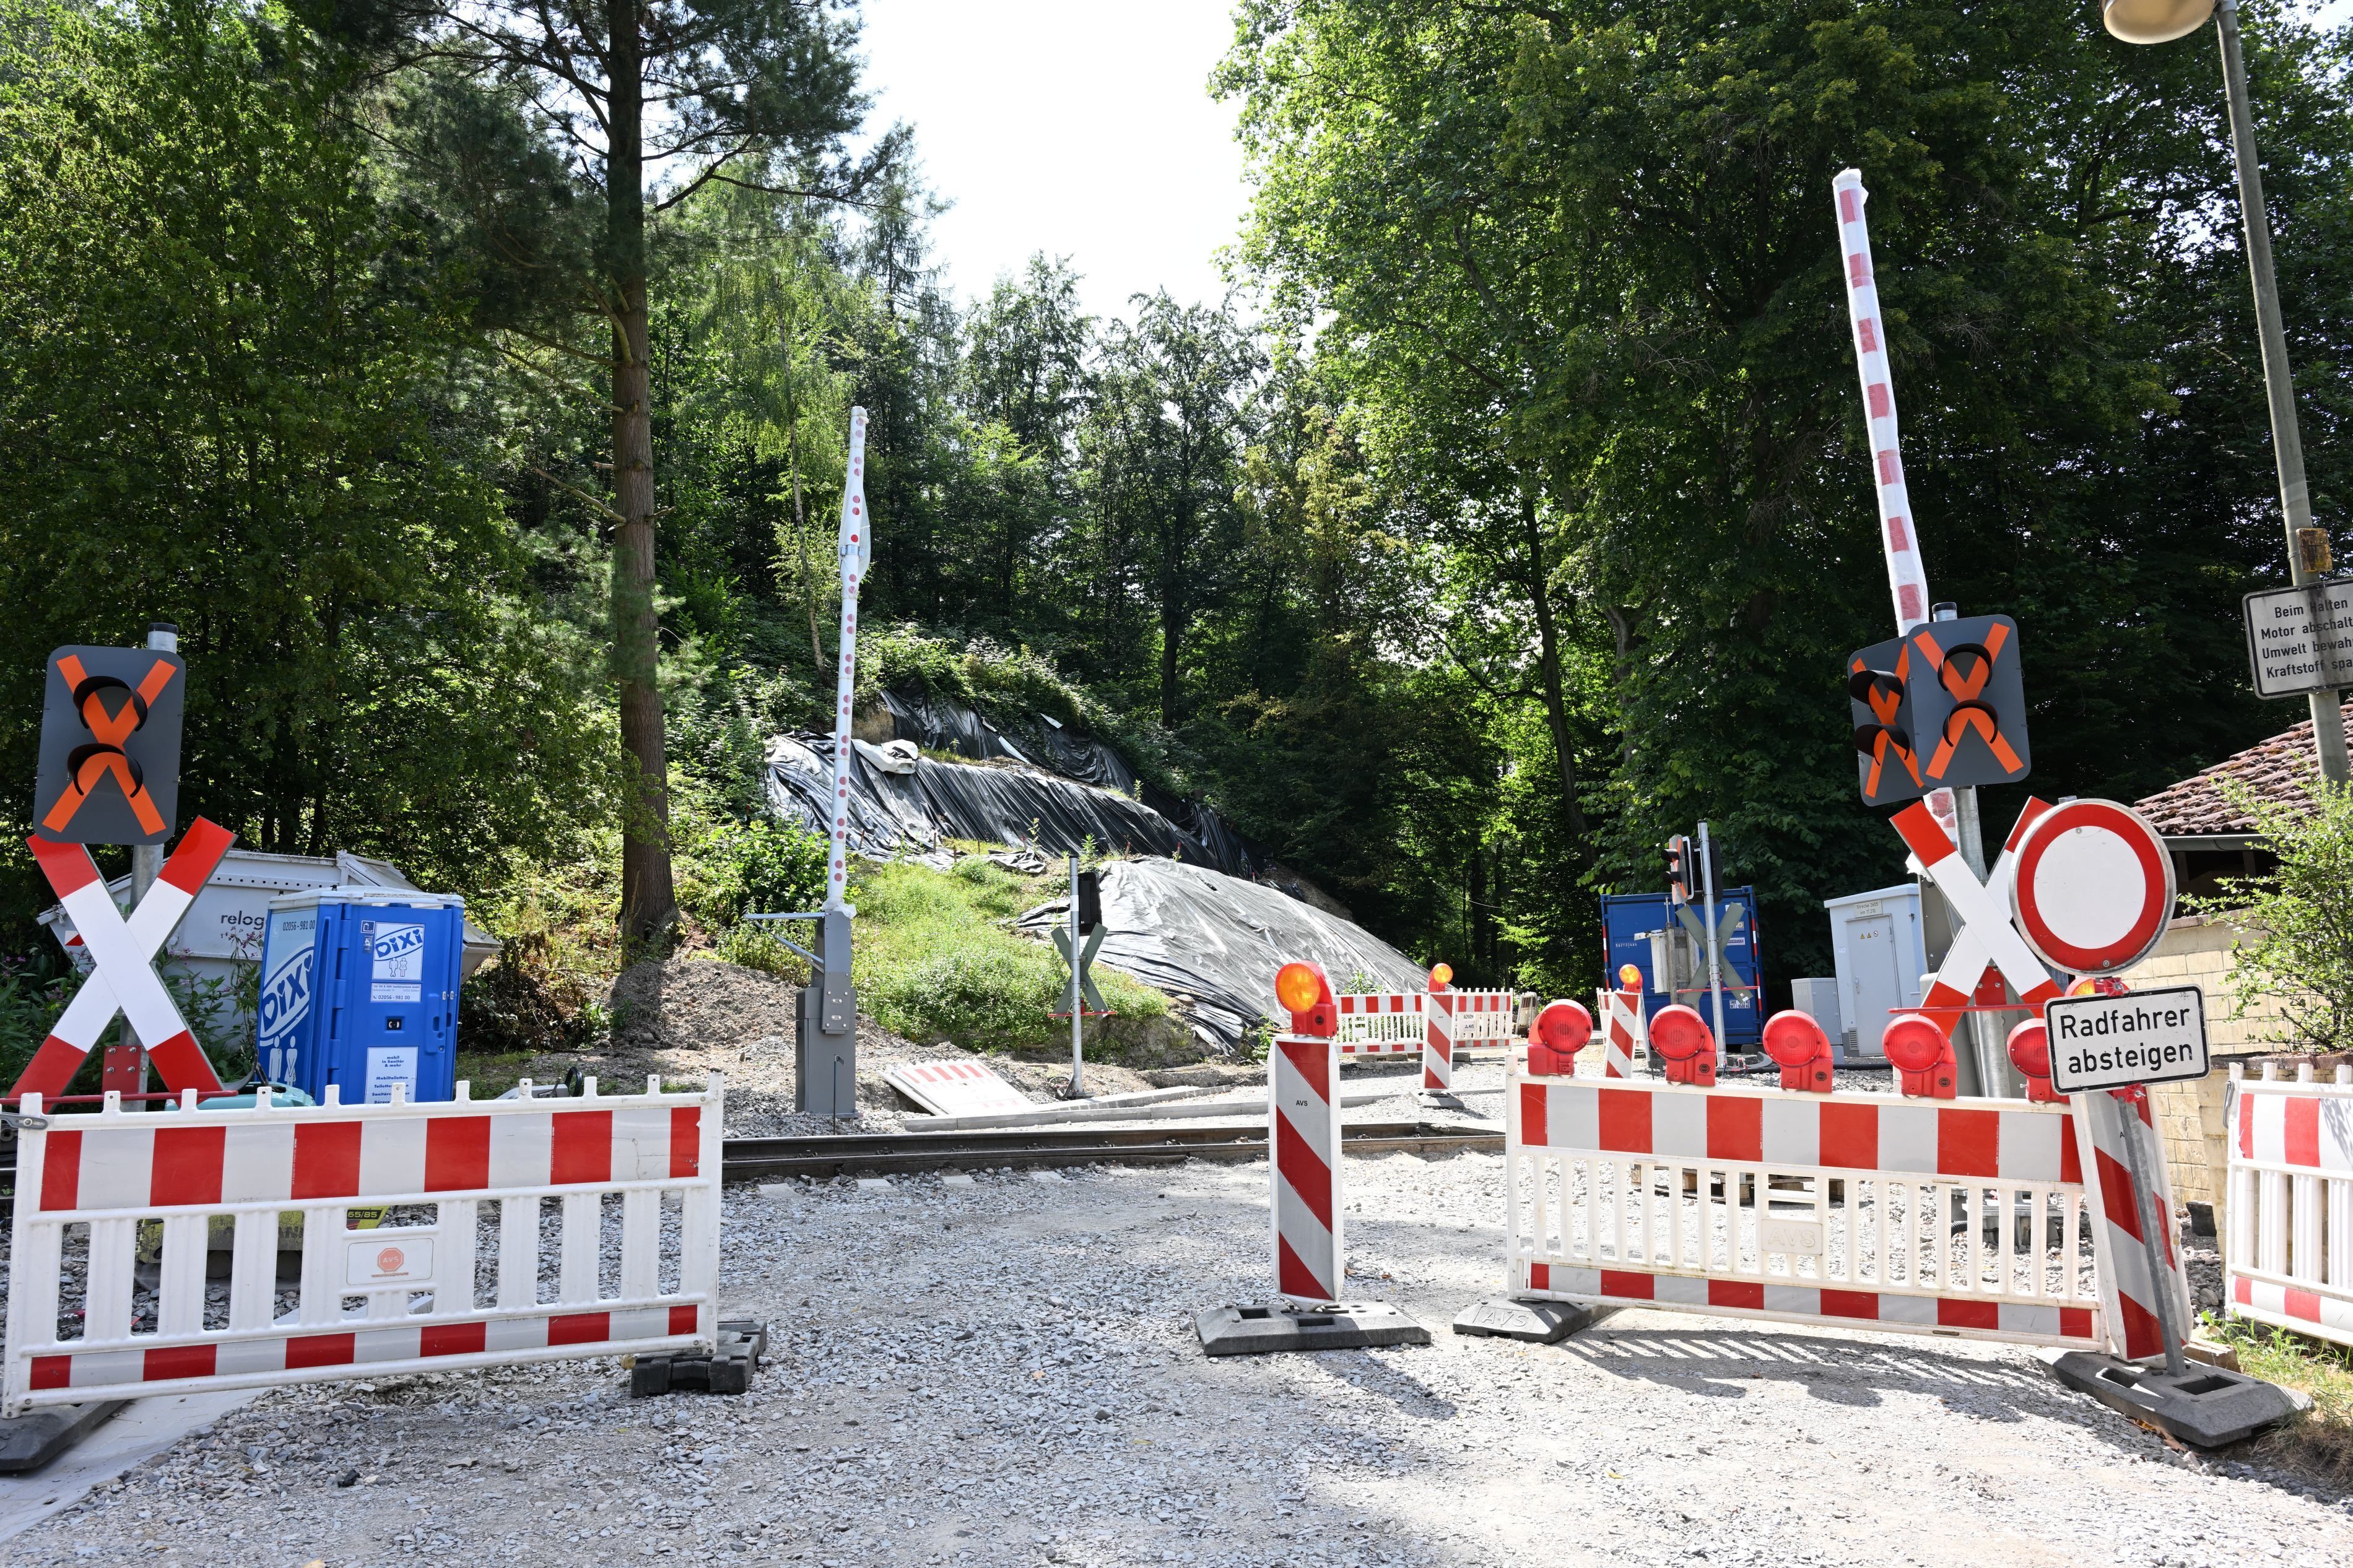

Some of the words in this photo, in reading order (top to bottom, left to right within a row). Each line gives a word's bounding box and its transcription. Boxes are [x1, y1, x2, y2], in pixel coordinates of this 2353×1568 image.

[2274, 605, 2304, 618] Beim
[2310, 599, 2348, 613] Halten
[2261, 626, 2295, 639] Motor
[2302, 617, 2353, 634] abschalt
[2262, 643, 2307, 659] Umwelt
[2312, 636, 2353, 652] bewah
[2266, 659, 2325, 678] Kraftstoff
[220, 910, 267, 930] relog
[2060, 1007, 2190, 1039] Radfahrer
[2068, 1042, 2193, 1074] absteigen
[1768, 1228, 1816, 1248] AVS
[1481, 1310, 1529, 1327] AVS
